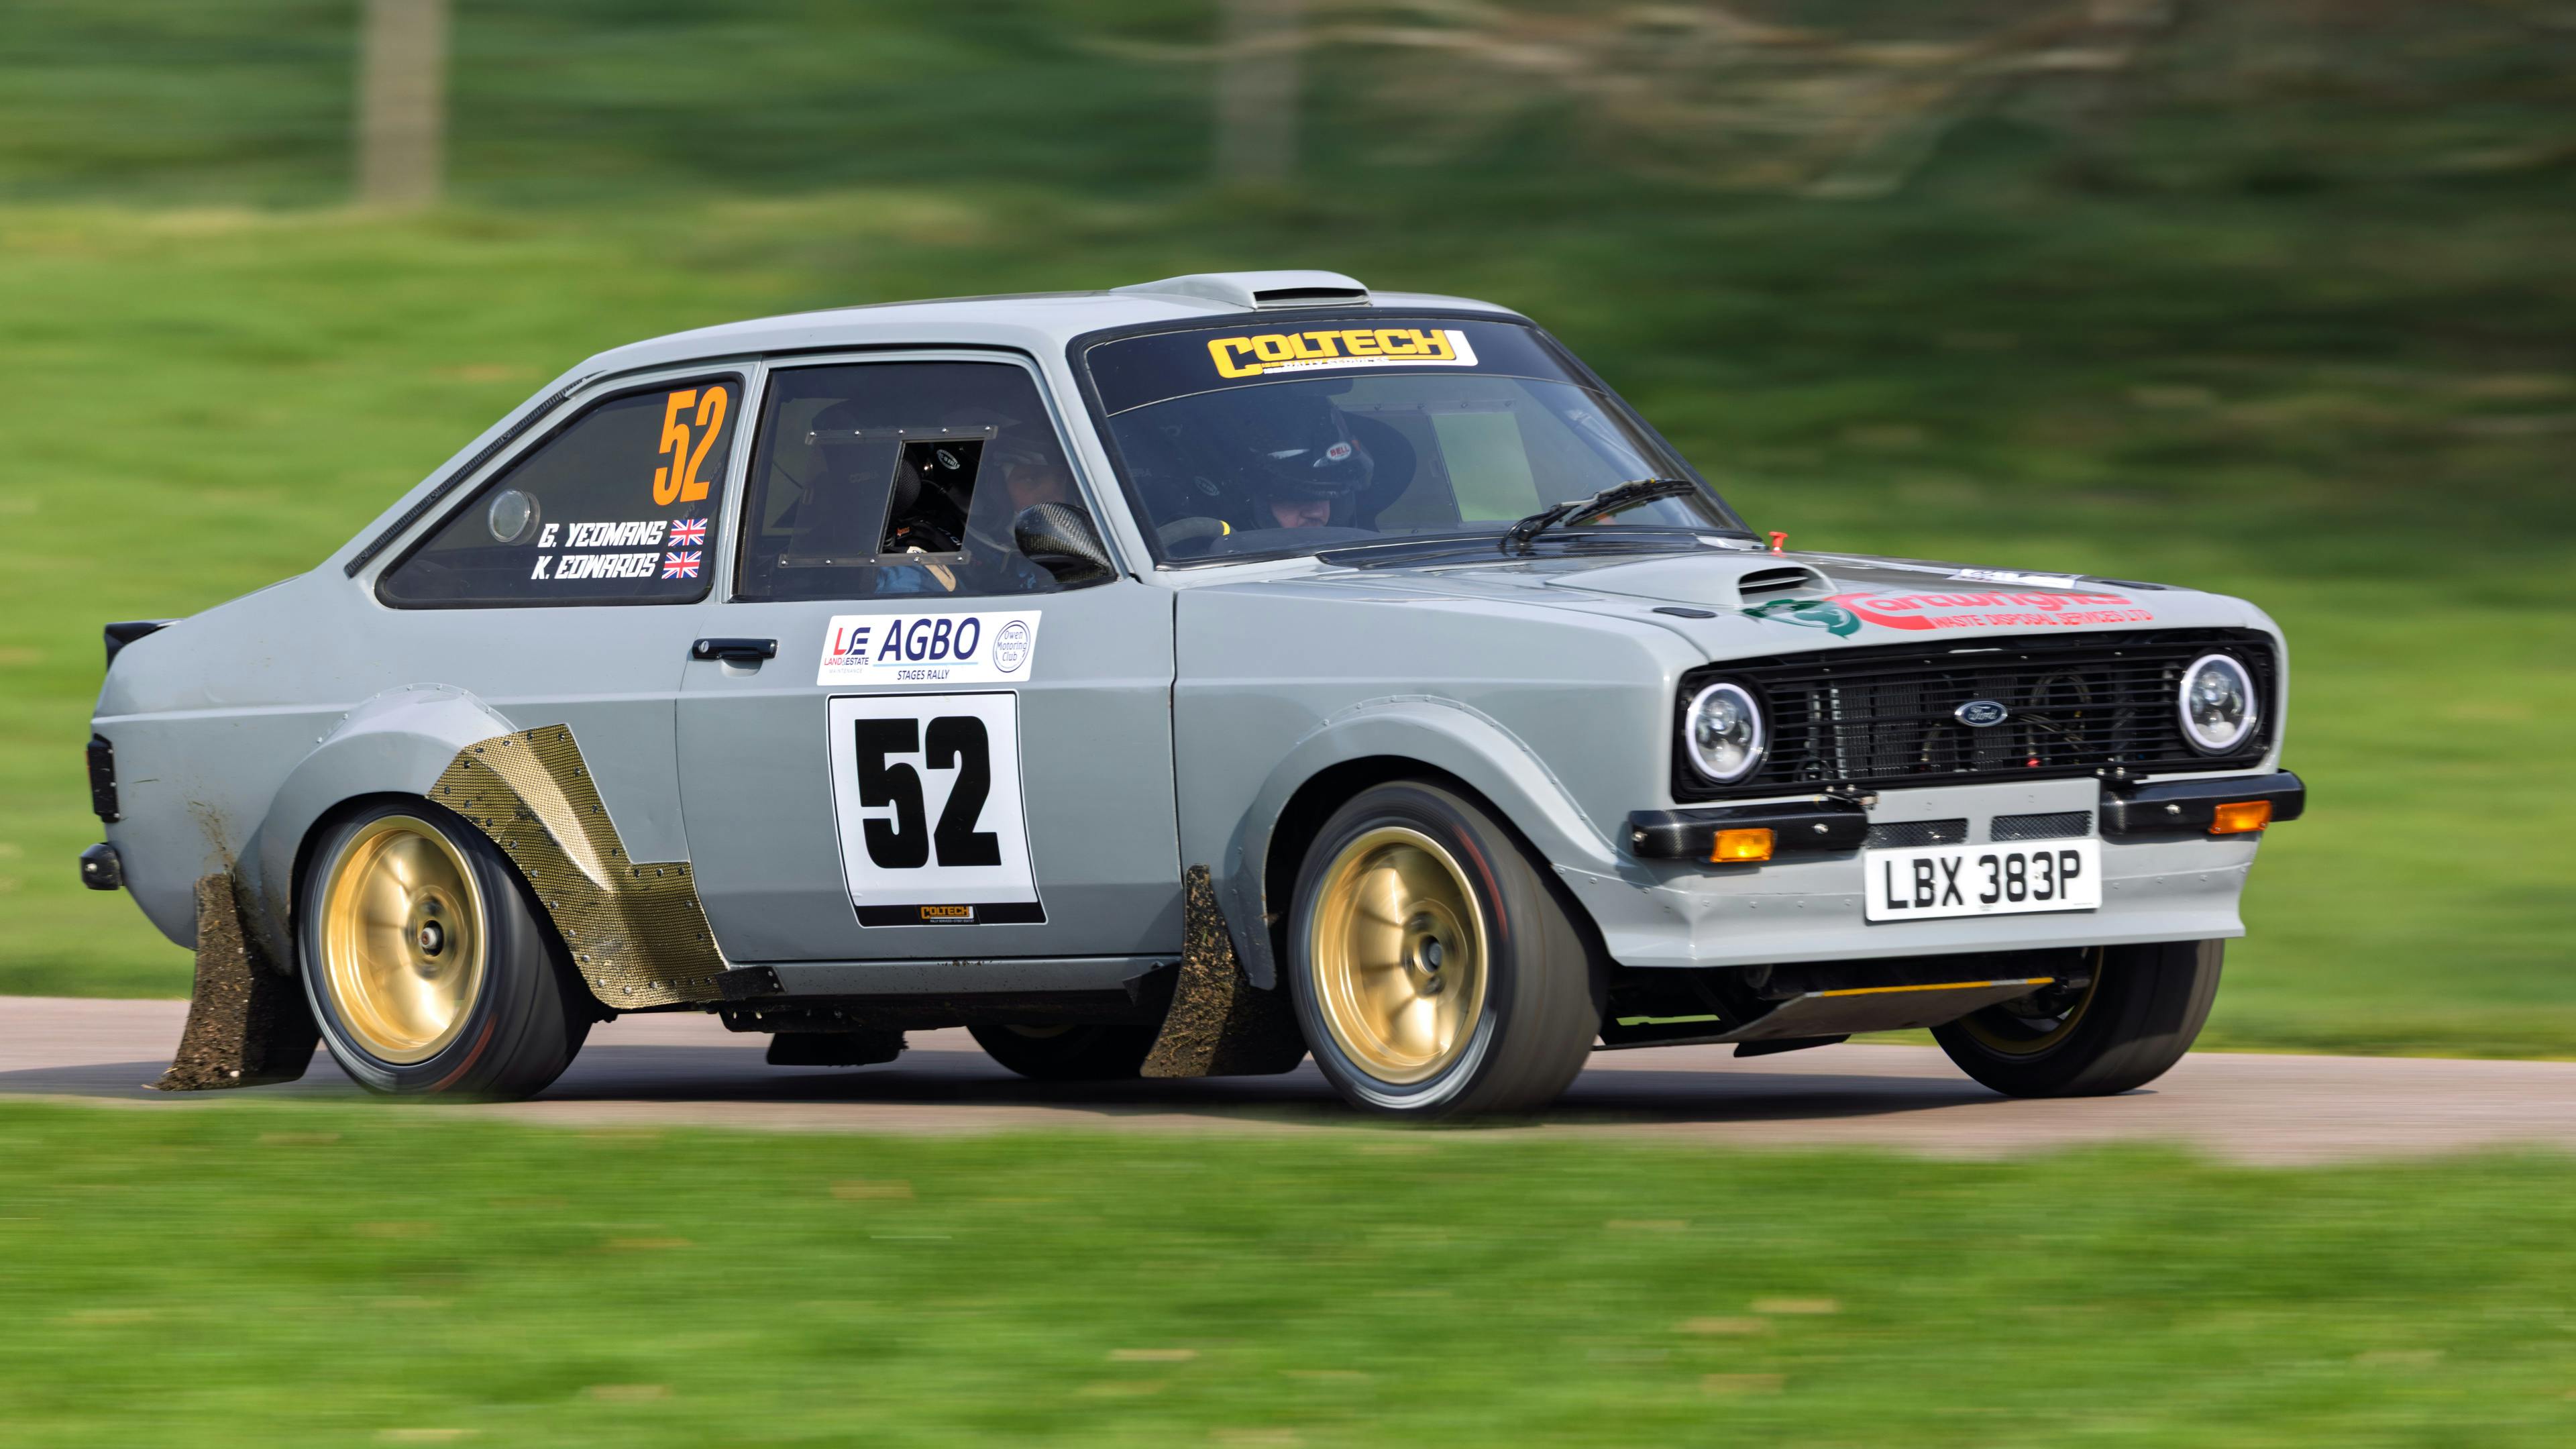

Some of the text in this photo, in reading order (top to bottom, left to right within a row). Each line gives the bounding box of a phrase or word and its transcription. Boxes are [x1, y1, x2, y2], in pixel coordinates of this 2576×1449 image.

[1208, 329, 1456, 378] COLTECH
[653, 386, 728, 505] 52
[1330, 444, 1350, 458] BELL
[565, 521, 667, 547] YEOMANS
[531, 553, 660, 580] K. EDWARDS
[1824, 591, 2132, 630] Cartwrights
[1929, 610, 2154, 629] WASTE DISPOSAL SERVICES LTD
[877, 617, 980, 661] AGBO
[1004, 630, 1023, 639] Owen
[998, 641, 1027, 652] Motoring
[1002, 651, 1018, 661] Club
[897, 669, 949, 680] STAGES RALLY
[1968, 706, 1998, 720] Ford
[855, 716, 1002, 868] 52
[1885, 850, 2081, 910] LBX 383P
[921, 906, 969, 919] COLTECH
